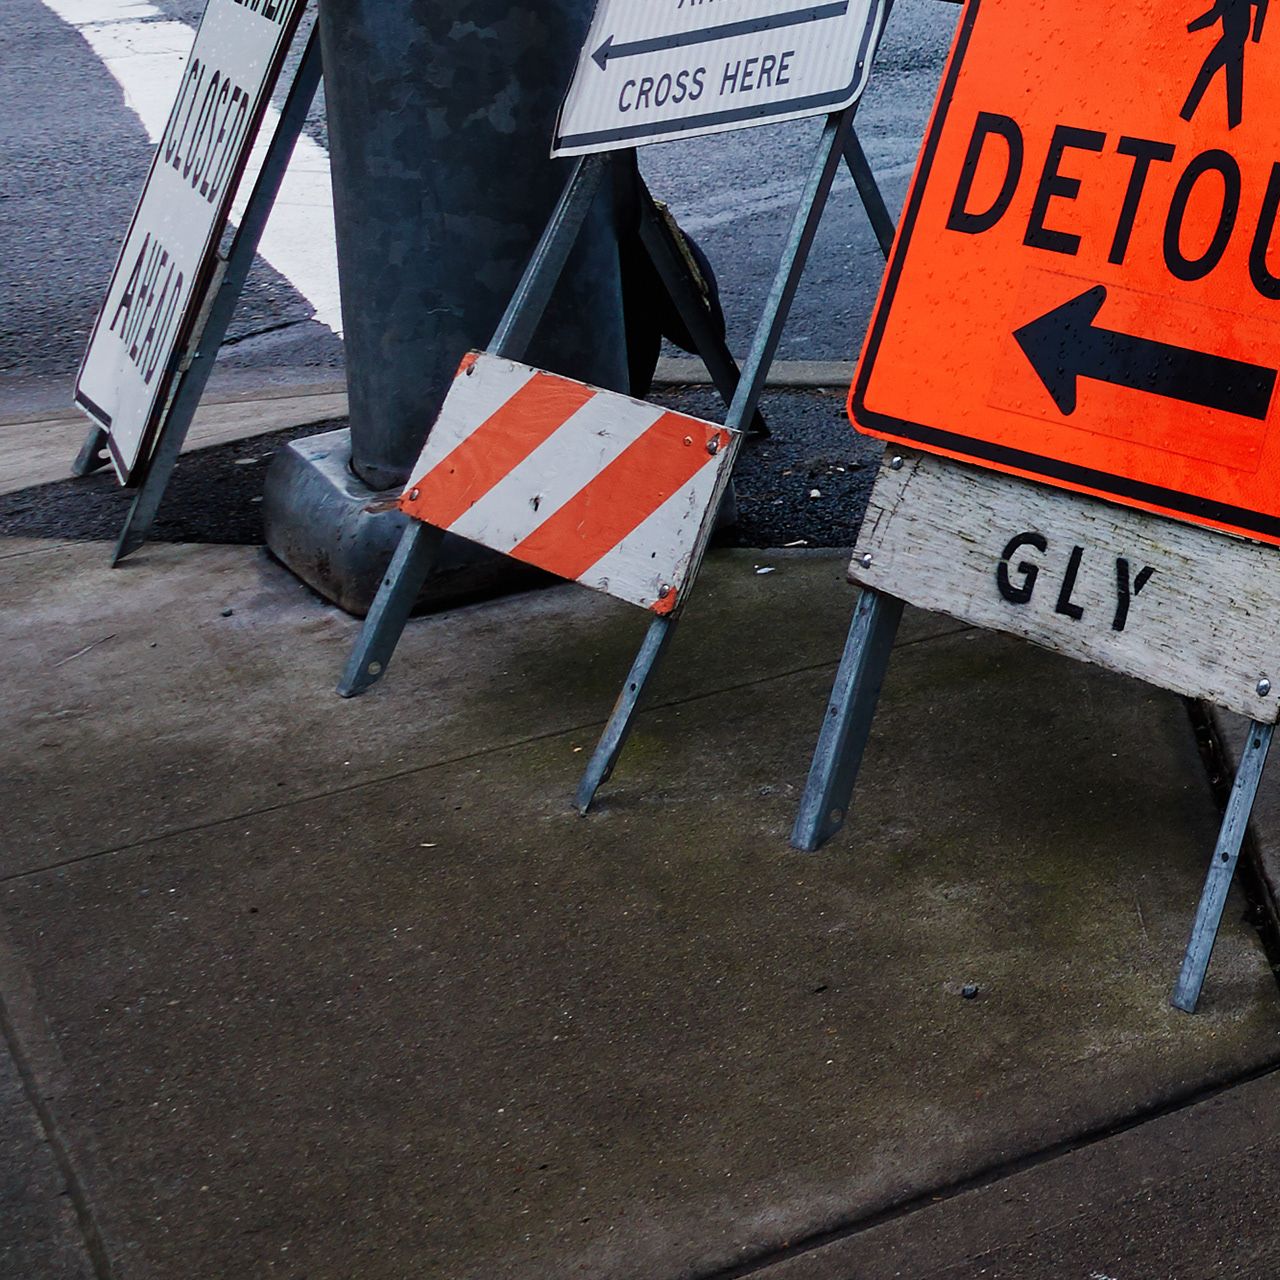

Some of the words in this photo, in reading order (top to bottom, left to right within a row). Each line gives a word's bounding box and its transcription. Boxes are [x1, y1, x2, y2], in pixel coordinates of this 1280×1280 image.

[165, 57, 250, 204] CLOSED
[618, 66, 706, 112] CROSS
[719, 50, 795, 96] HERE
[109, 232, 184, 386] AHEAD
[997, 531, 1155, 632] GLY
